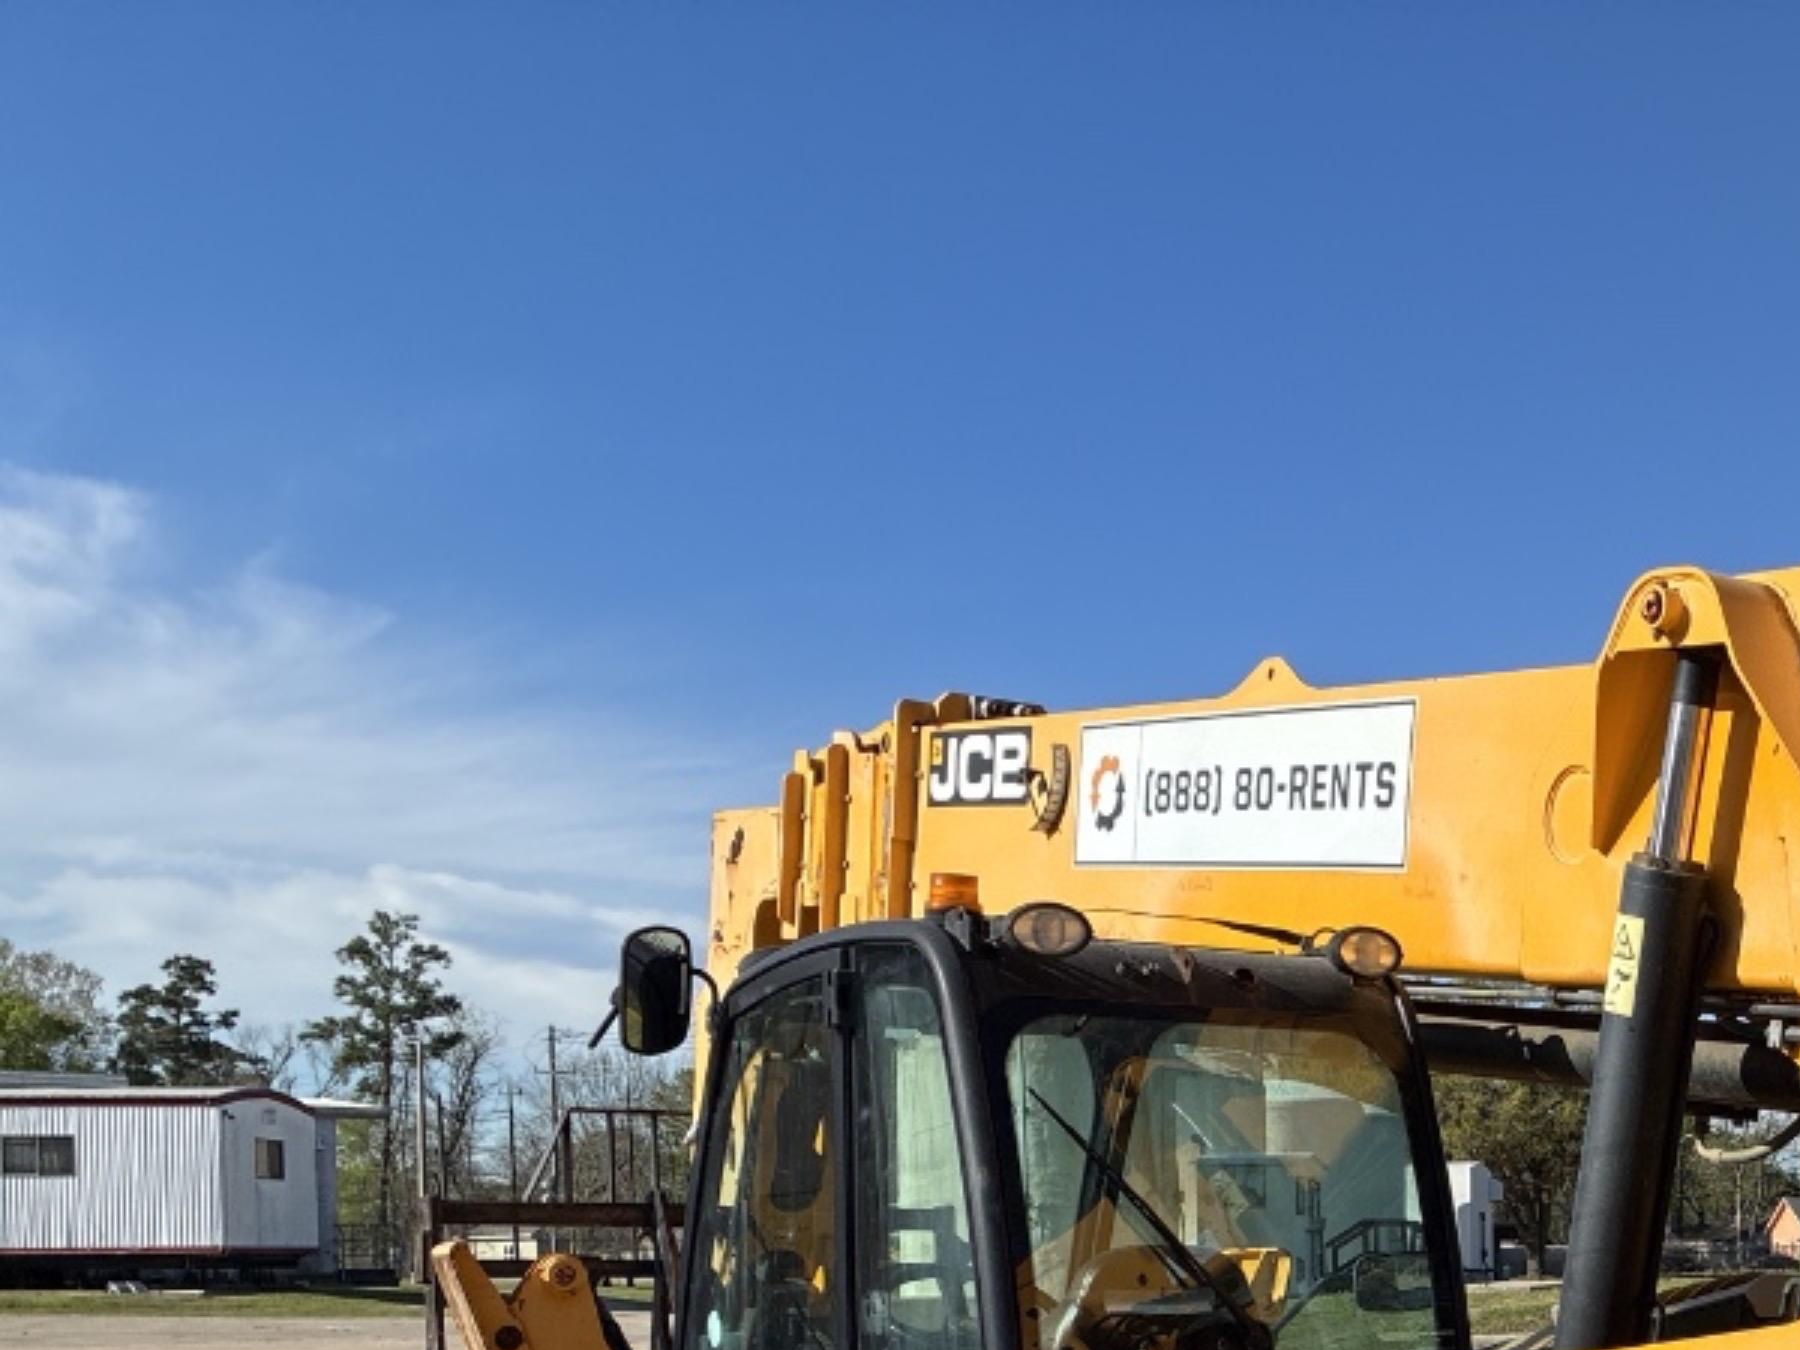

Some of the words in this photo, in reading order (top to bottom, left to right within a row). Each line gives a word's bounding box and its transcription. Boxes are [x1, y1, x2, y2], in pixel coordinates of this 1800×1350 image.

[930, 732, 1029, 802] JCB
[1145, 765, 1222, 816] (888)
[1234, 762, 1396, 811] 80-RENTS
